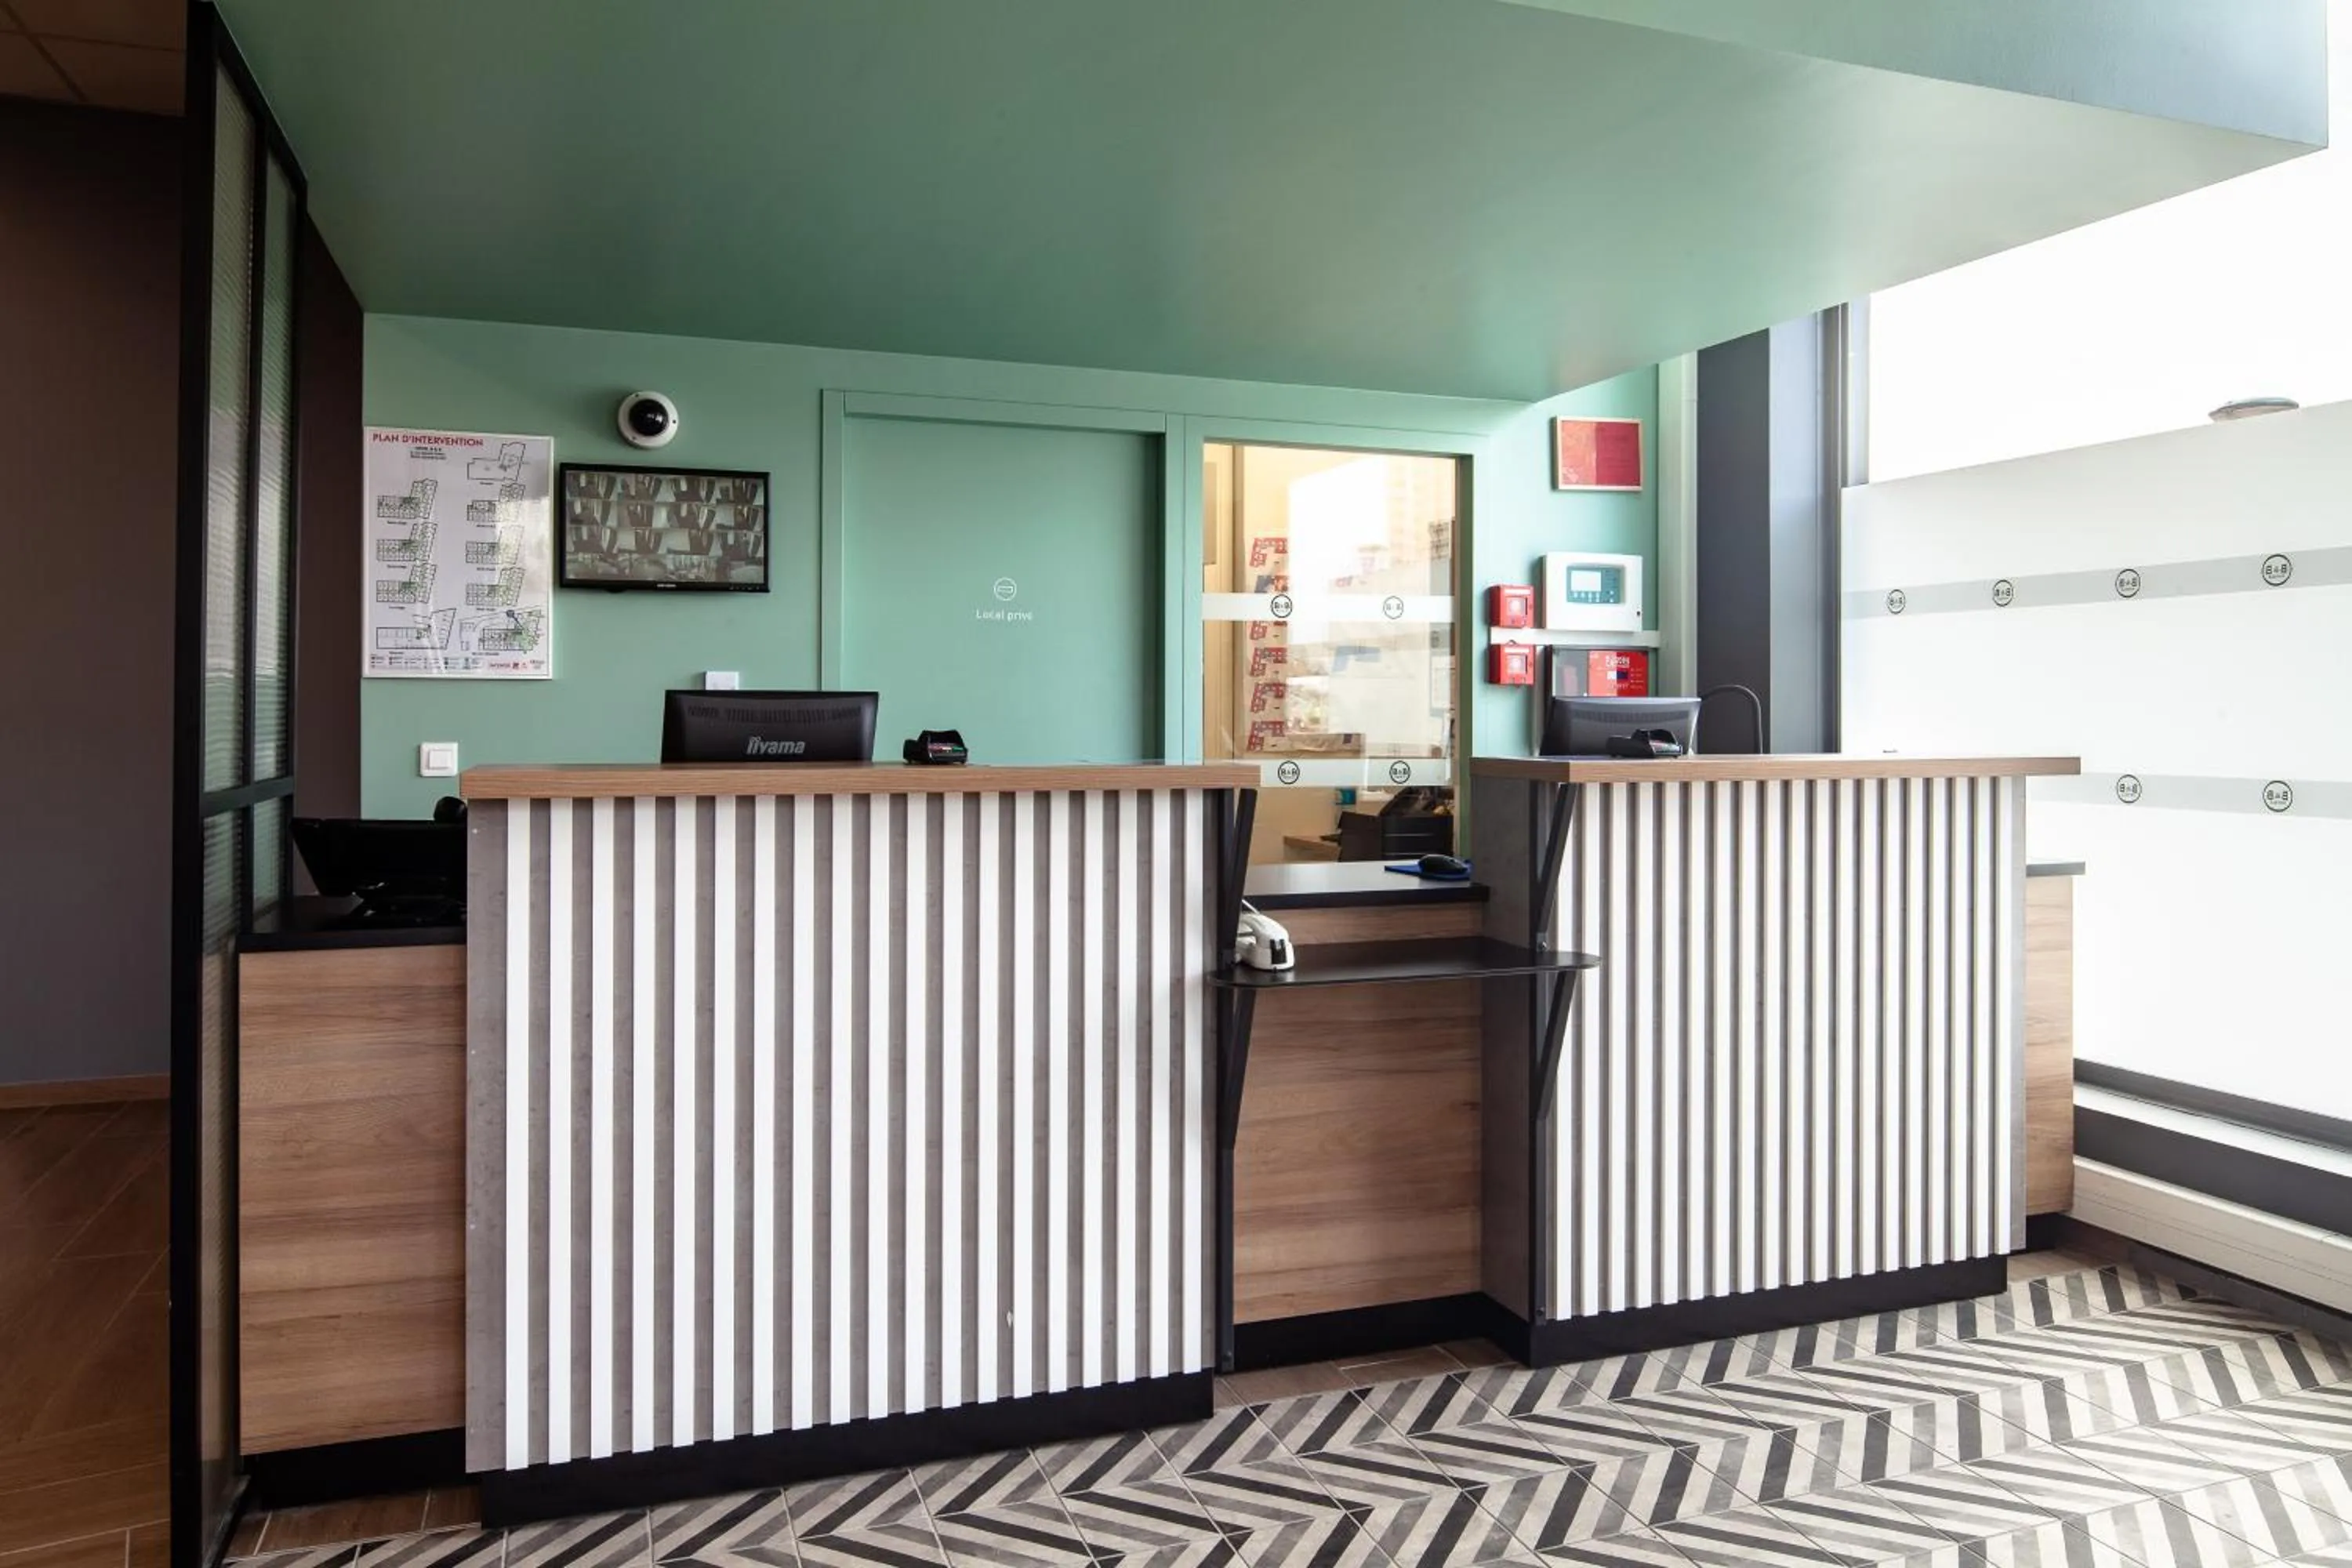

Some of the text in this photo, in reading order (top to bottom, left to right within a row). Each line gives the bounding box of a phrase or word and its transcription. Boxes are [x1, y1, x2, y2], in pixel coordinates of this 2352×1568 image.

[372, 433, 484, 446] PLAN D'INTERVENTION
[976, 608, 1004, 619] Local
